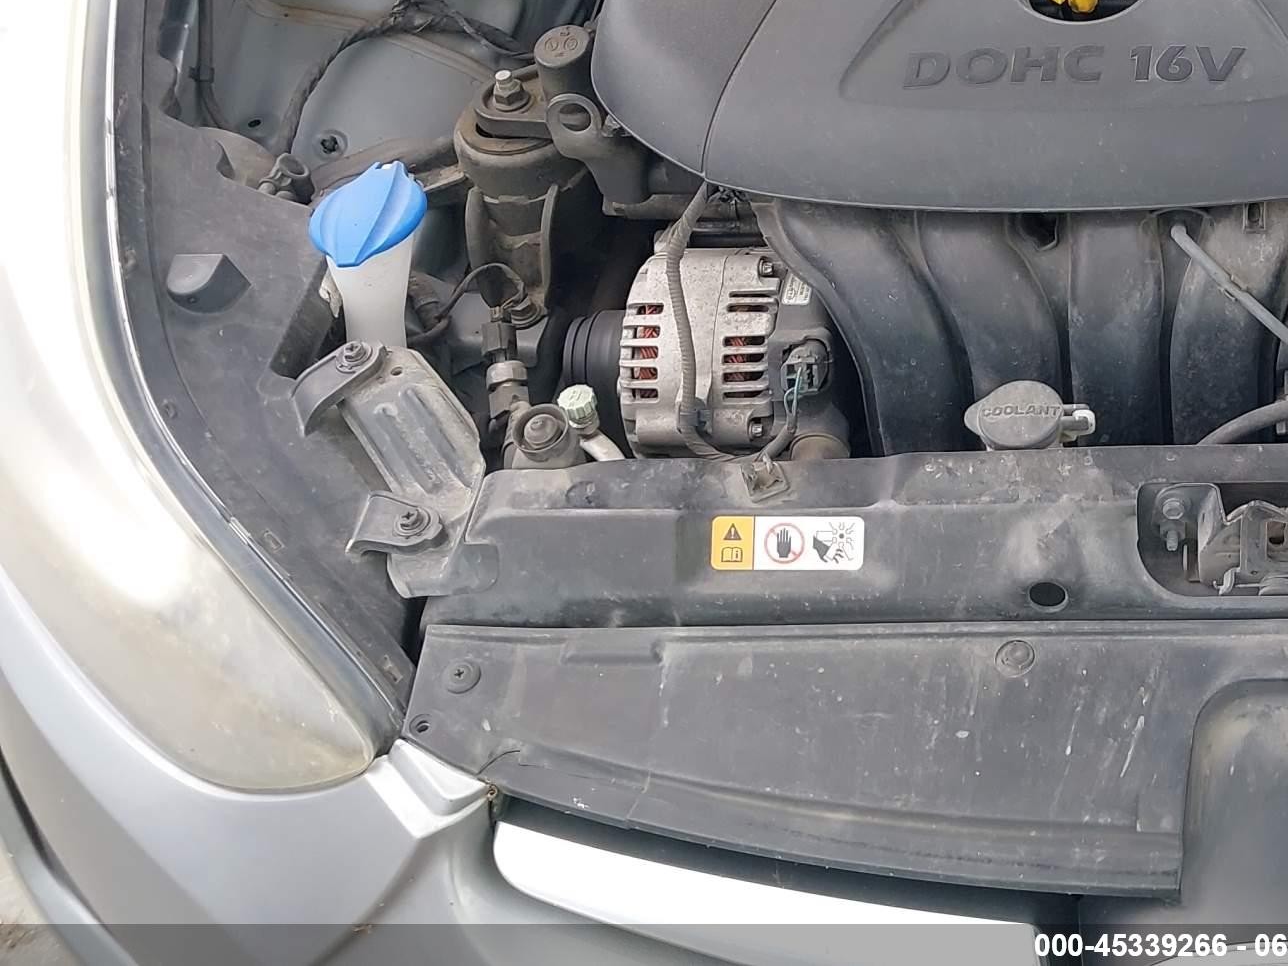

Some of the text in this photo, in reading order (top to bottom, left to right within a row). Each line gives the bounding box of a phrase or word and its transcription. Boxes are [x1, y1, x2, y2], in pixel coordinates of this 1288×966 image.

[902, 44, 1247, 89] DOHC 16V
[981, 404, 1061, 418] COOLANT
